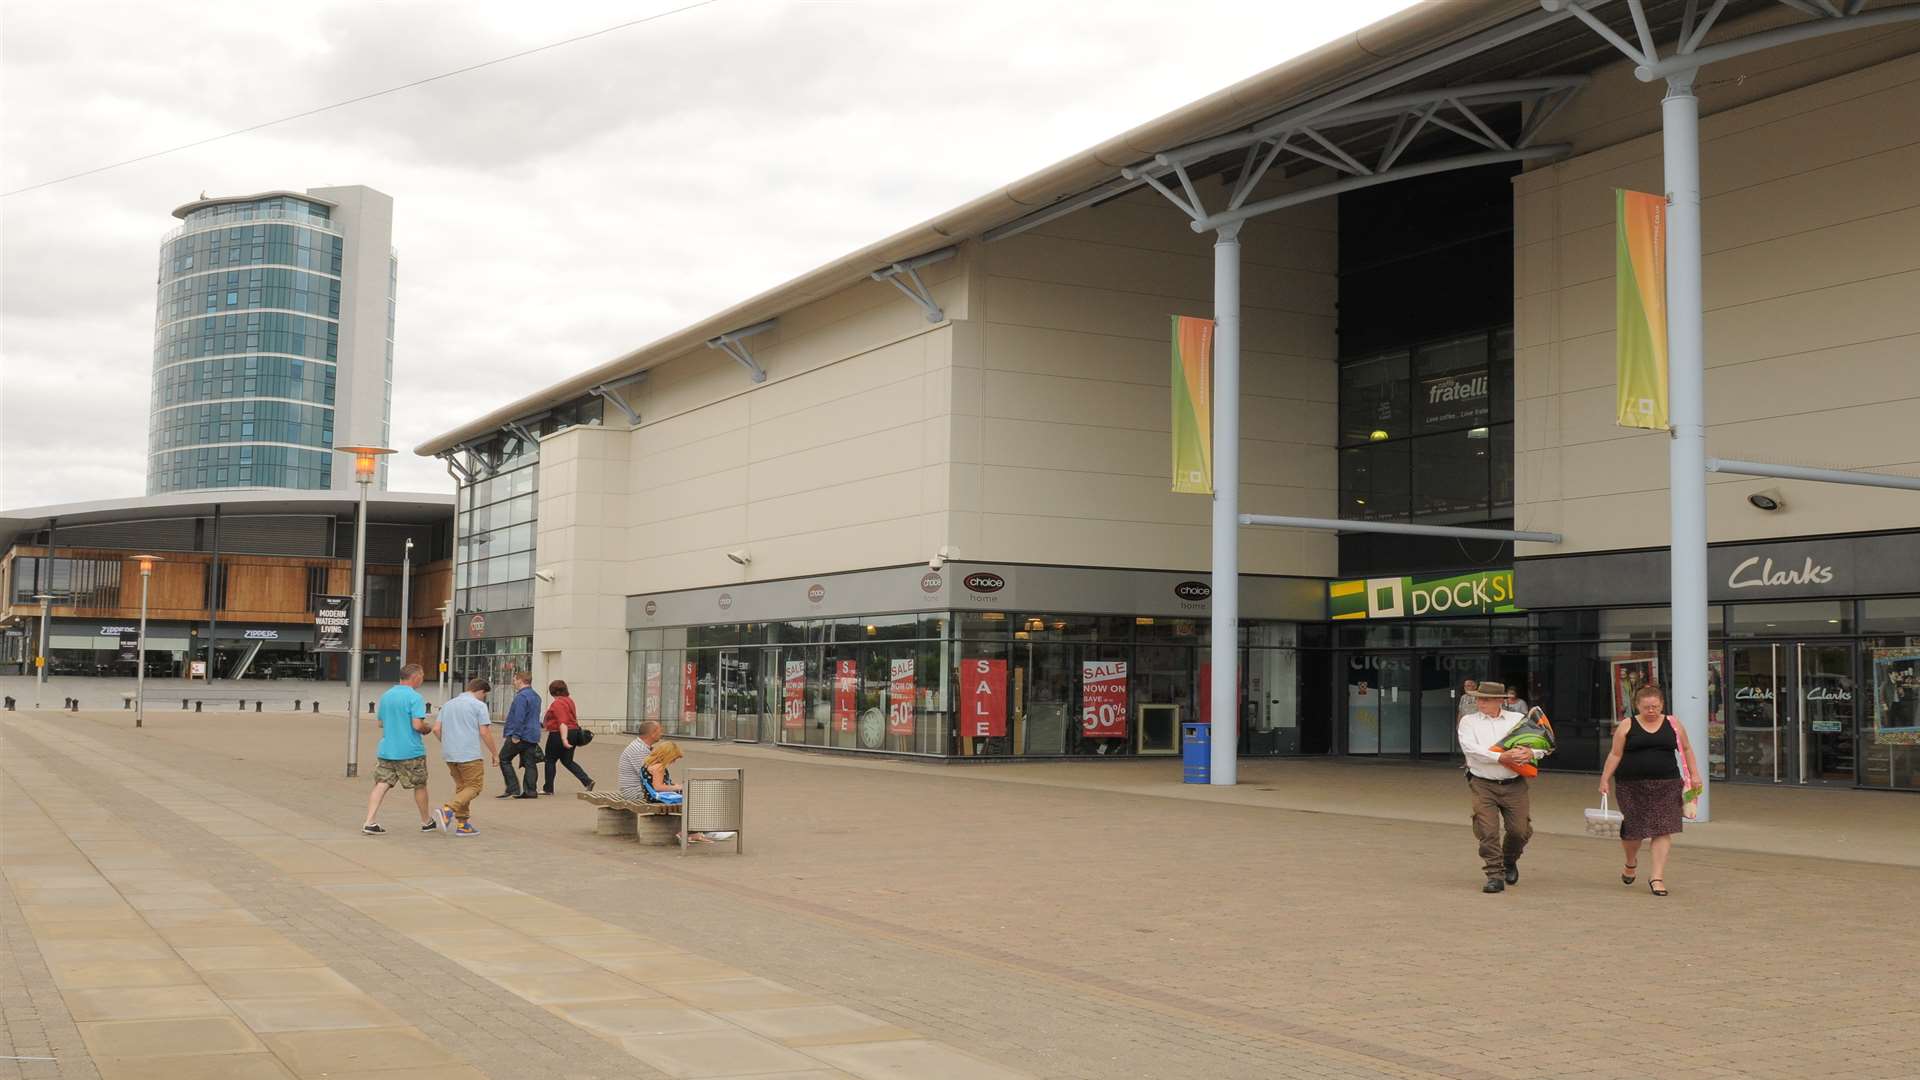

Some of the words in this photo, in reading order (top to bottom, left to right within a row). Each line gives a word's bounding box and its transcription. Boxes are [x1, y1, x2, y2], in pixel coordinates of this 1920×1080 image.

[1429, 376, 1488, 404] fratelli
[1728, 556, 1833, 588] Clarks
[969, 578, 1002, 588] choice
[969, 593, 998, 603] home
[1180, 586, 1211, 596] choice
[320, 609, 347, 618] MODERN
[1181, 602, 1206, 610] home
[315, 617, 350, 626] WATERSIDE
[243, 629, 279, 639] ZIPPERS
[786, 661, 804, 677] SALE
[891, 659, 914, 677] SALE
[1083, 662, 1126, 680] SALE
[841, 660, 850, 731] SALE
[1083, 685, 1107, 693] NOW
[1110, 684, 1126, 693] ON
[1807, 686, 1852, 701] Clarks
[976, 660, 991, 736] SALE
[1083, 703, 1127, 730] 50%
